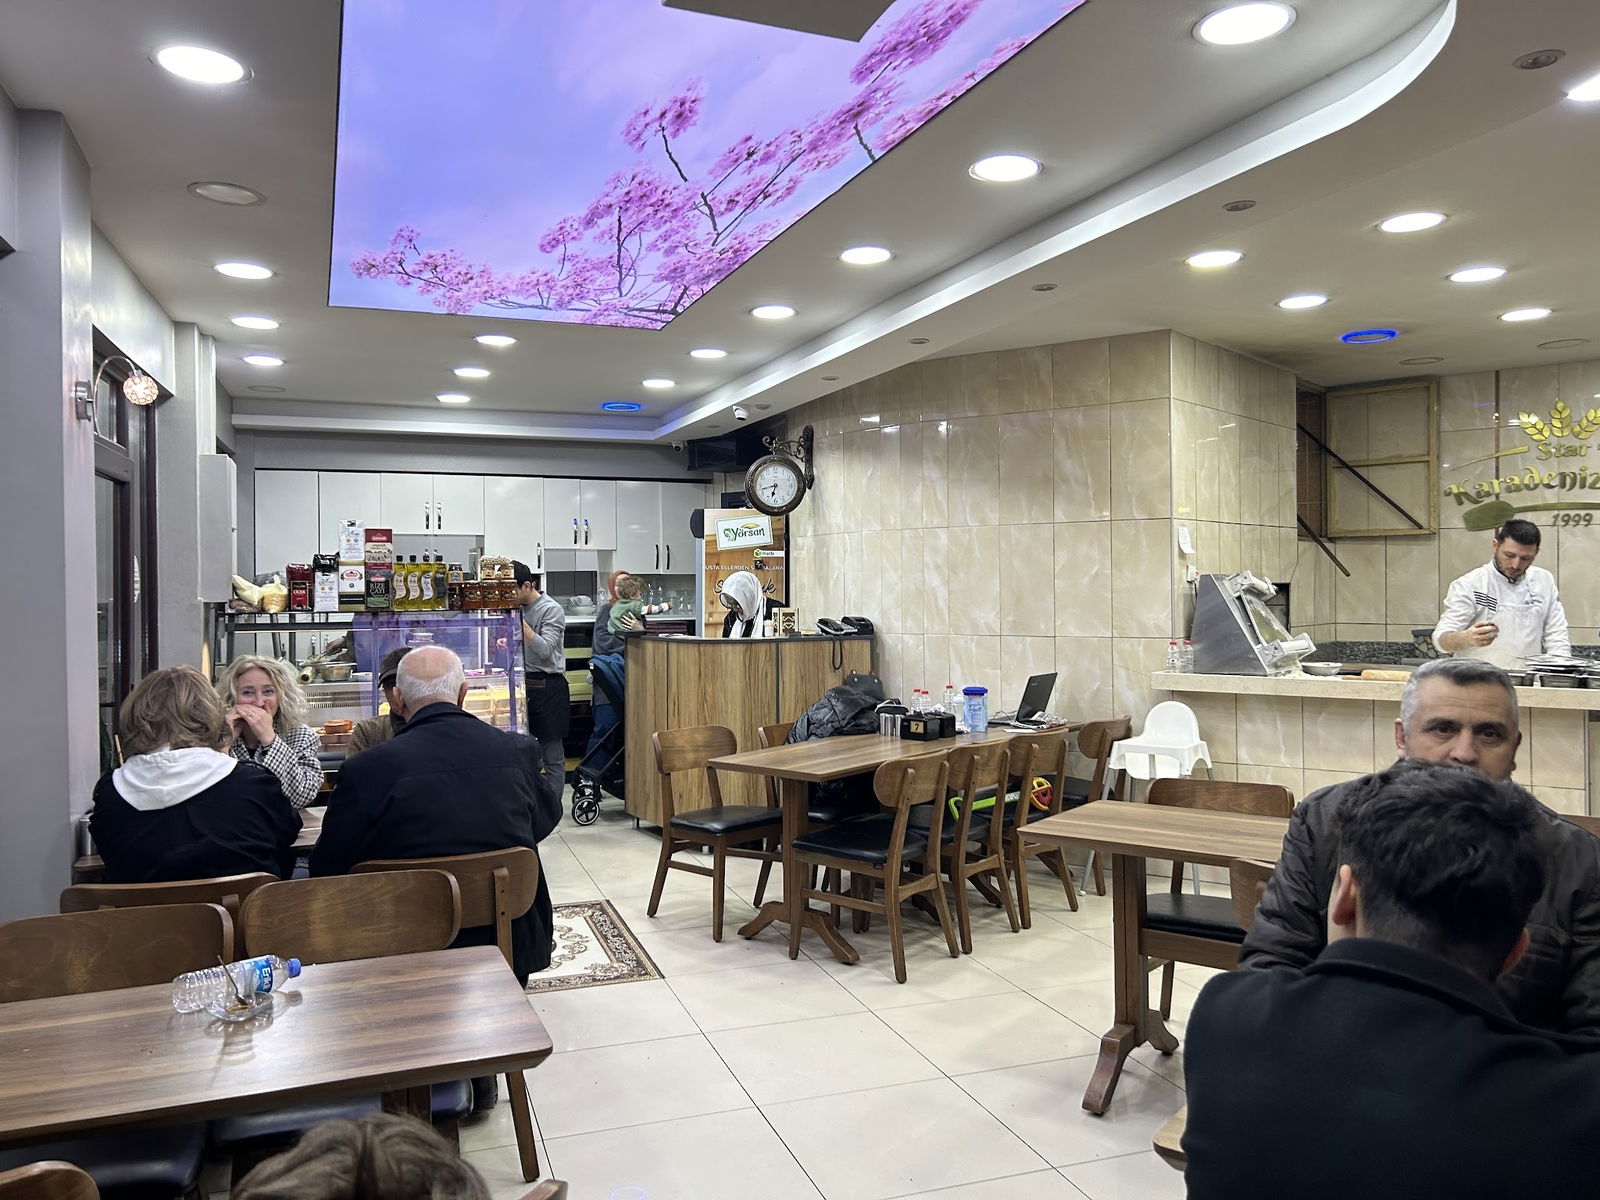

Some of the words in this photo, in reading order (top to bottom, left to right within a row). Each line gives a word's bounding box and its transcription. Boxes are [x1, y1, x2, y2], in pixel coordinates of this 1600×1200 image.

[1536, 440, 1592, 460] Star
[1443, 465, 1600, 506] Karadeniz
[1550, 512, 1593, 528] 1999
[731, 527, 765, 541] Yörsan
[914, 723, 920, 731] 7
